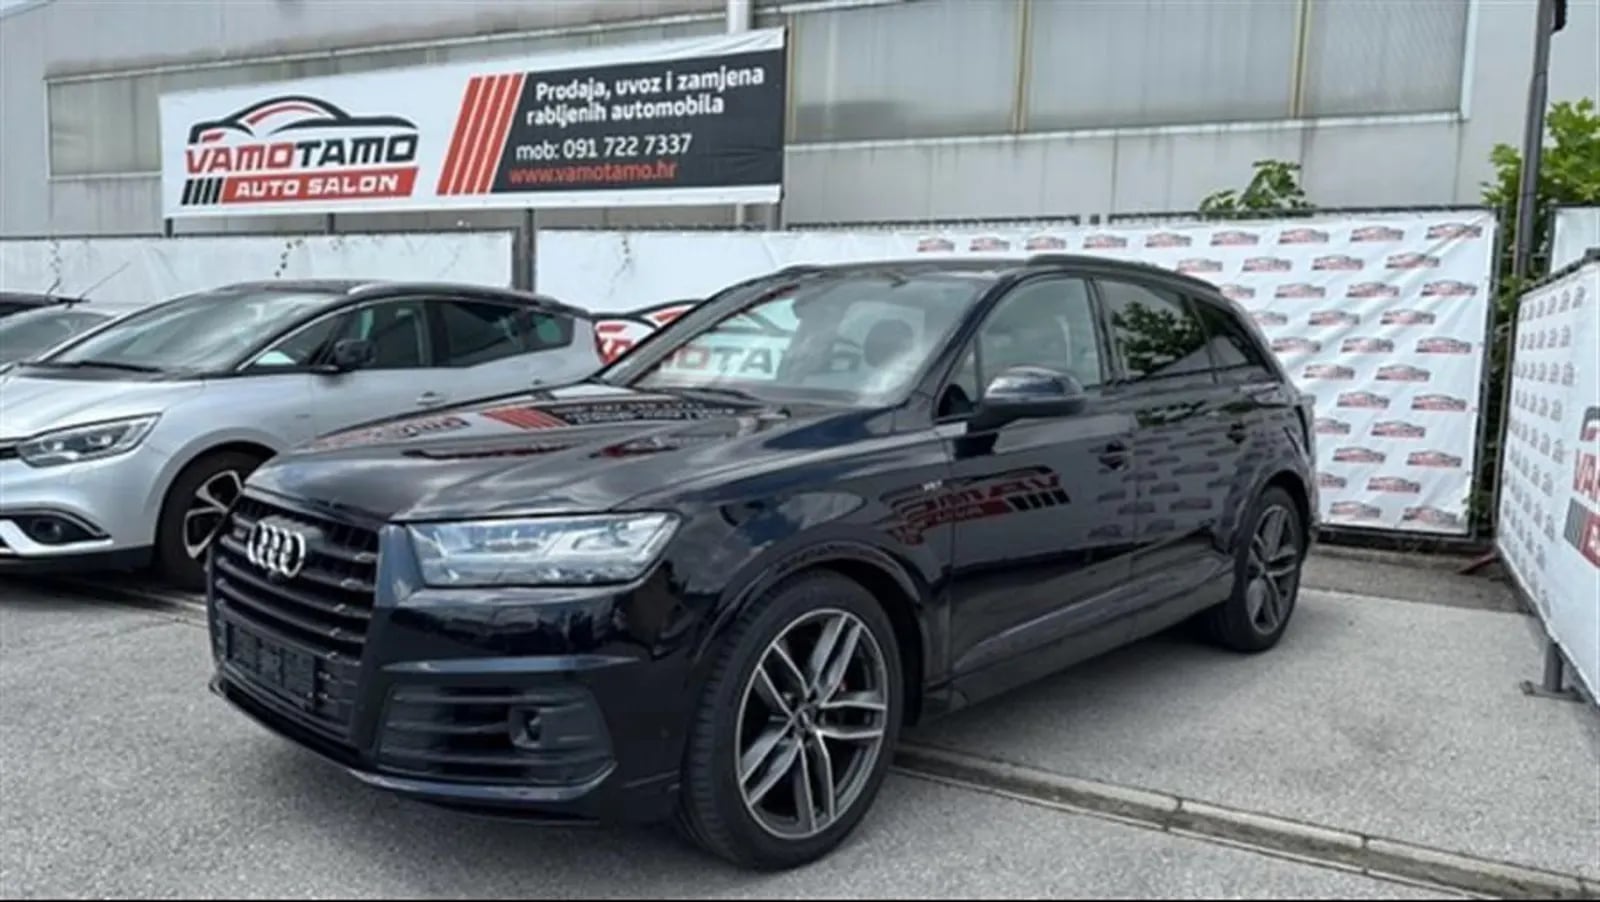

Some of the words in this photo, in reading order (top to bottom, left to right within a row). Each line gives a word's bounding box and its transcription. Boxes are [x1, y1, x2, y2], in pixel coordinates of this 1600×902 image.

[536, 78, 610, 101] Prodaja,
[615, 74, 662, 95] uvoz
[666, 71, 672, 91] i
[677, 66, 765, 92] zamjena
[526, 103, 607, 128] rabljenih
[611, 96, 725, 120] automobila
[186, 134, 418, 174] VAMOTAMO
[516, 140, 560, 160] mob:
[563, 138, 598, 159] 091
[603, 136, 638, 156] 722
[644, 133, 693, 155] 7337
[235, 178, 299, 198] AUTO
[307, 174, 399, 195] SALON
[508, 161, 677, 184] www.vamotamo.hr
